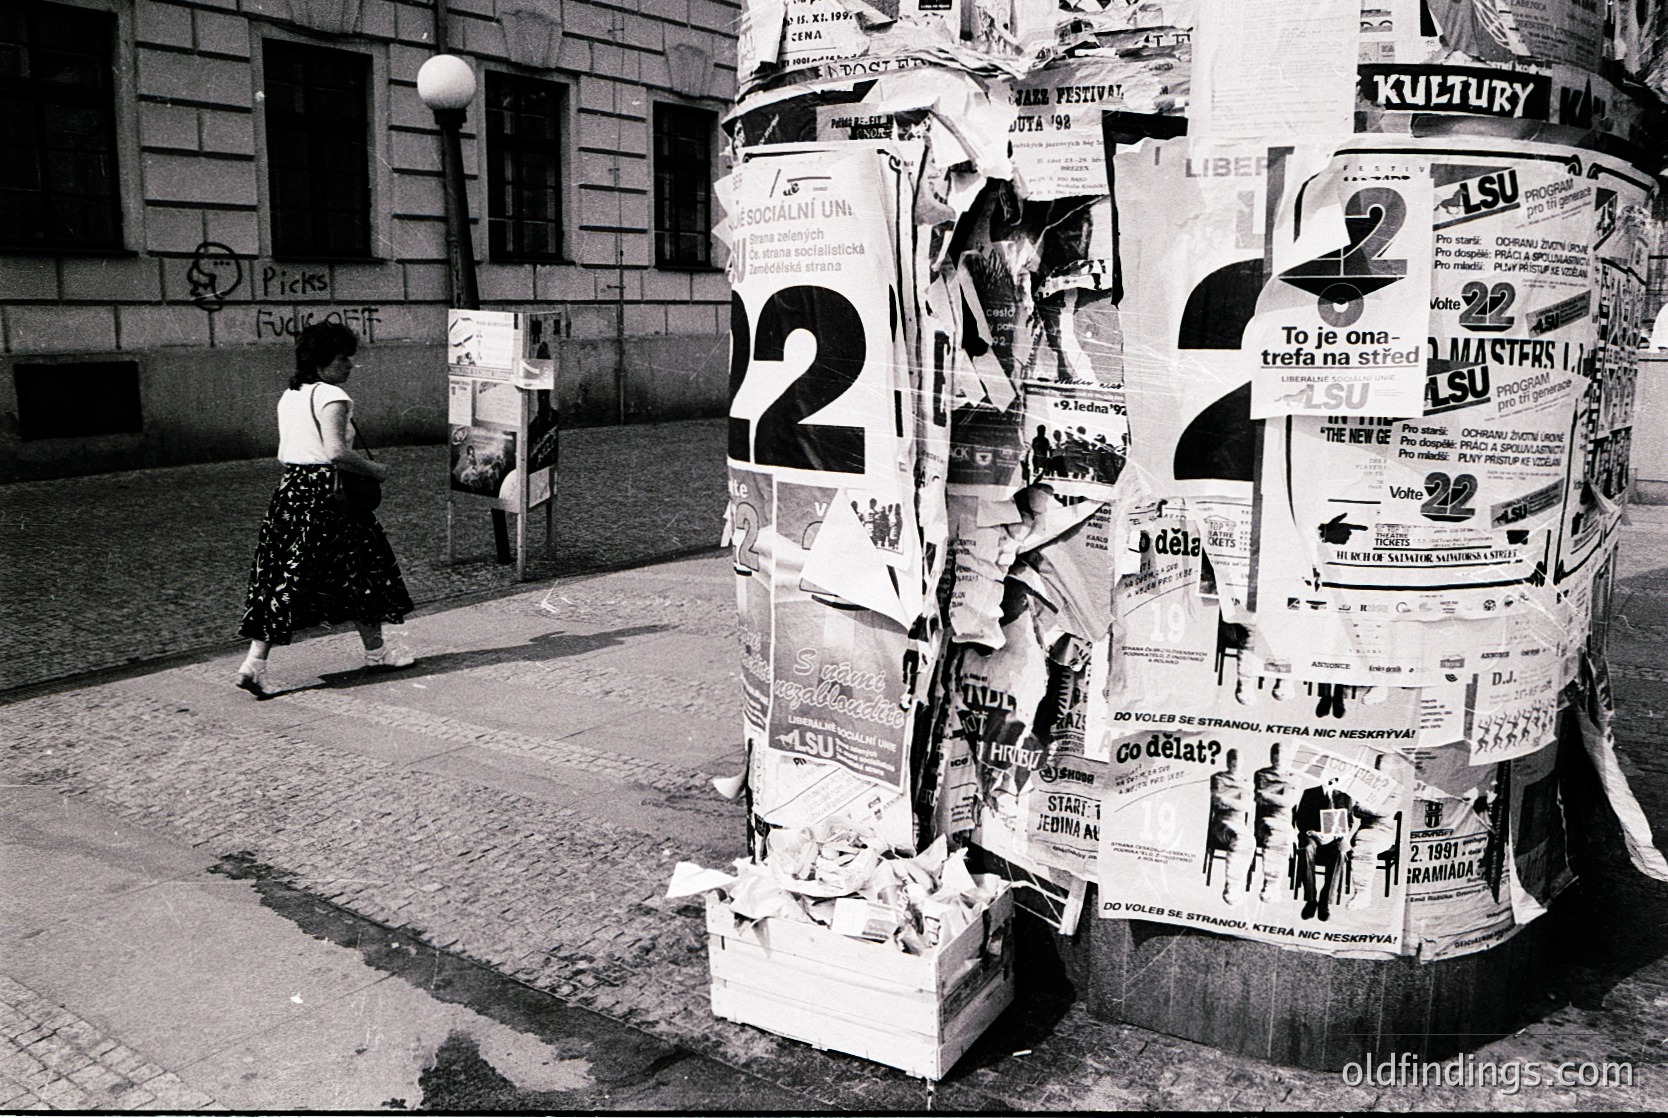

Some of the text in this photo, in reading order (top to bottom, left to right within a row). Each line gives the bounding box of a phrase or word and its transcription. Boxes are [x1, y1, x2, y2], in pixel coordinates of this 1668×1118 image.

[791, 30, 822, 42] CENA
[1015, 87, 1049, 106] JAZZ
[1373, 74, 1534, 118] KULTURY
[1051, 114, 1071, 130] '92
[1459, 169, 1520, 214] LSU
[1524, 178, 1575, 201] PROGRAM
[747, 198, 815, 226] SOCIÁLNÍ
[1527, 200, 1545, 219] pro
[1559, 187, 1592, 210] generace
[750, 228, 824, 246] Strana zelených
[1436, 235, 1451, 245] Pro
[1495, 236, 1538, 249] OCHRANU
[763, 246, 791, 260] strana
[794, 242, 865, 257] socialistická
[1435, 248, 1451, 258] Pro
[1494, 247, 1530, 261] PRÁCI A
[749, 259, 842, 275] Zemědělská strana
[1434, 260, 1450, 271] Pro
[1494, 261, 1559, 275] PLNÝ PŘÍSTUP KE
[262, 267, 329, 296] Picks
[1430, 281, 1517, 325] Volte 22
[1281, 326, 1309, 345] To
[1315, 326, 1338, 349] je
[1261, 345, 1420, 366] trefa na střed
[1429, 365, 1490, 408] LSU
[1496, 372, 1551, 398] PROGRAM
[1303, 383, 1371, 410] LSU
[1498, 396, 1515, 413] pro
[1532, 379, 1573, 401] generace
[1349, 428, 1374, 444] NEW
[1376, 429, 1392, 445] GE
[1402, 424, 1418, 435] Pro
[1461, 428, 1508, 440] OCHRANU
[1400, 435, 1416, 447] Pro
[1460, 439, 1498, 452] PRÁCI A
[1399, 449, 1415, 459] Pro
[1458, 451, 1530, 466] PLNÝ PŘÍSTUP KE
[1389, 472, 1479, 515] Volte 22
[1086, 542, 1109, 551] PRAHA
[1375, 538, 1411, 547] TICKETS
[1372, 551, 1385, 562] OF
[1387, 552, 1434, 563] SALVATOR
[1150, 602, 1186, 643] 19
[793, 648, 817, 675] S
[822, 662, 887, 692] námi
[1311, 660, 1351, 670] ANNONCE
[1114, 711, 1416, 740] DO VOLEB SE STRANOU, KTERÁ NIC NESKRÝVÁ!
[792, 729, 834, 758] LSU
[878, 738, 897, 753] UNIE
[1145, 732, 1222, 765] dělat?
[1048, 796, 1091, 817] START:
[1410, 845, 1423, 862] 2.
[1427, 842, 1459, 861] 1991
[1103, 902, 1399, 946] DO VOLEB SE STRANOU, KTERÁ NIC NESKRÝVÁ!
